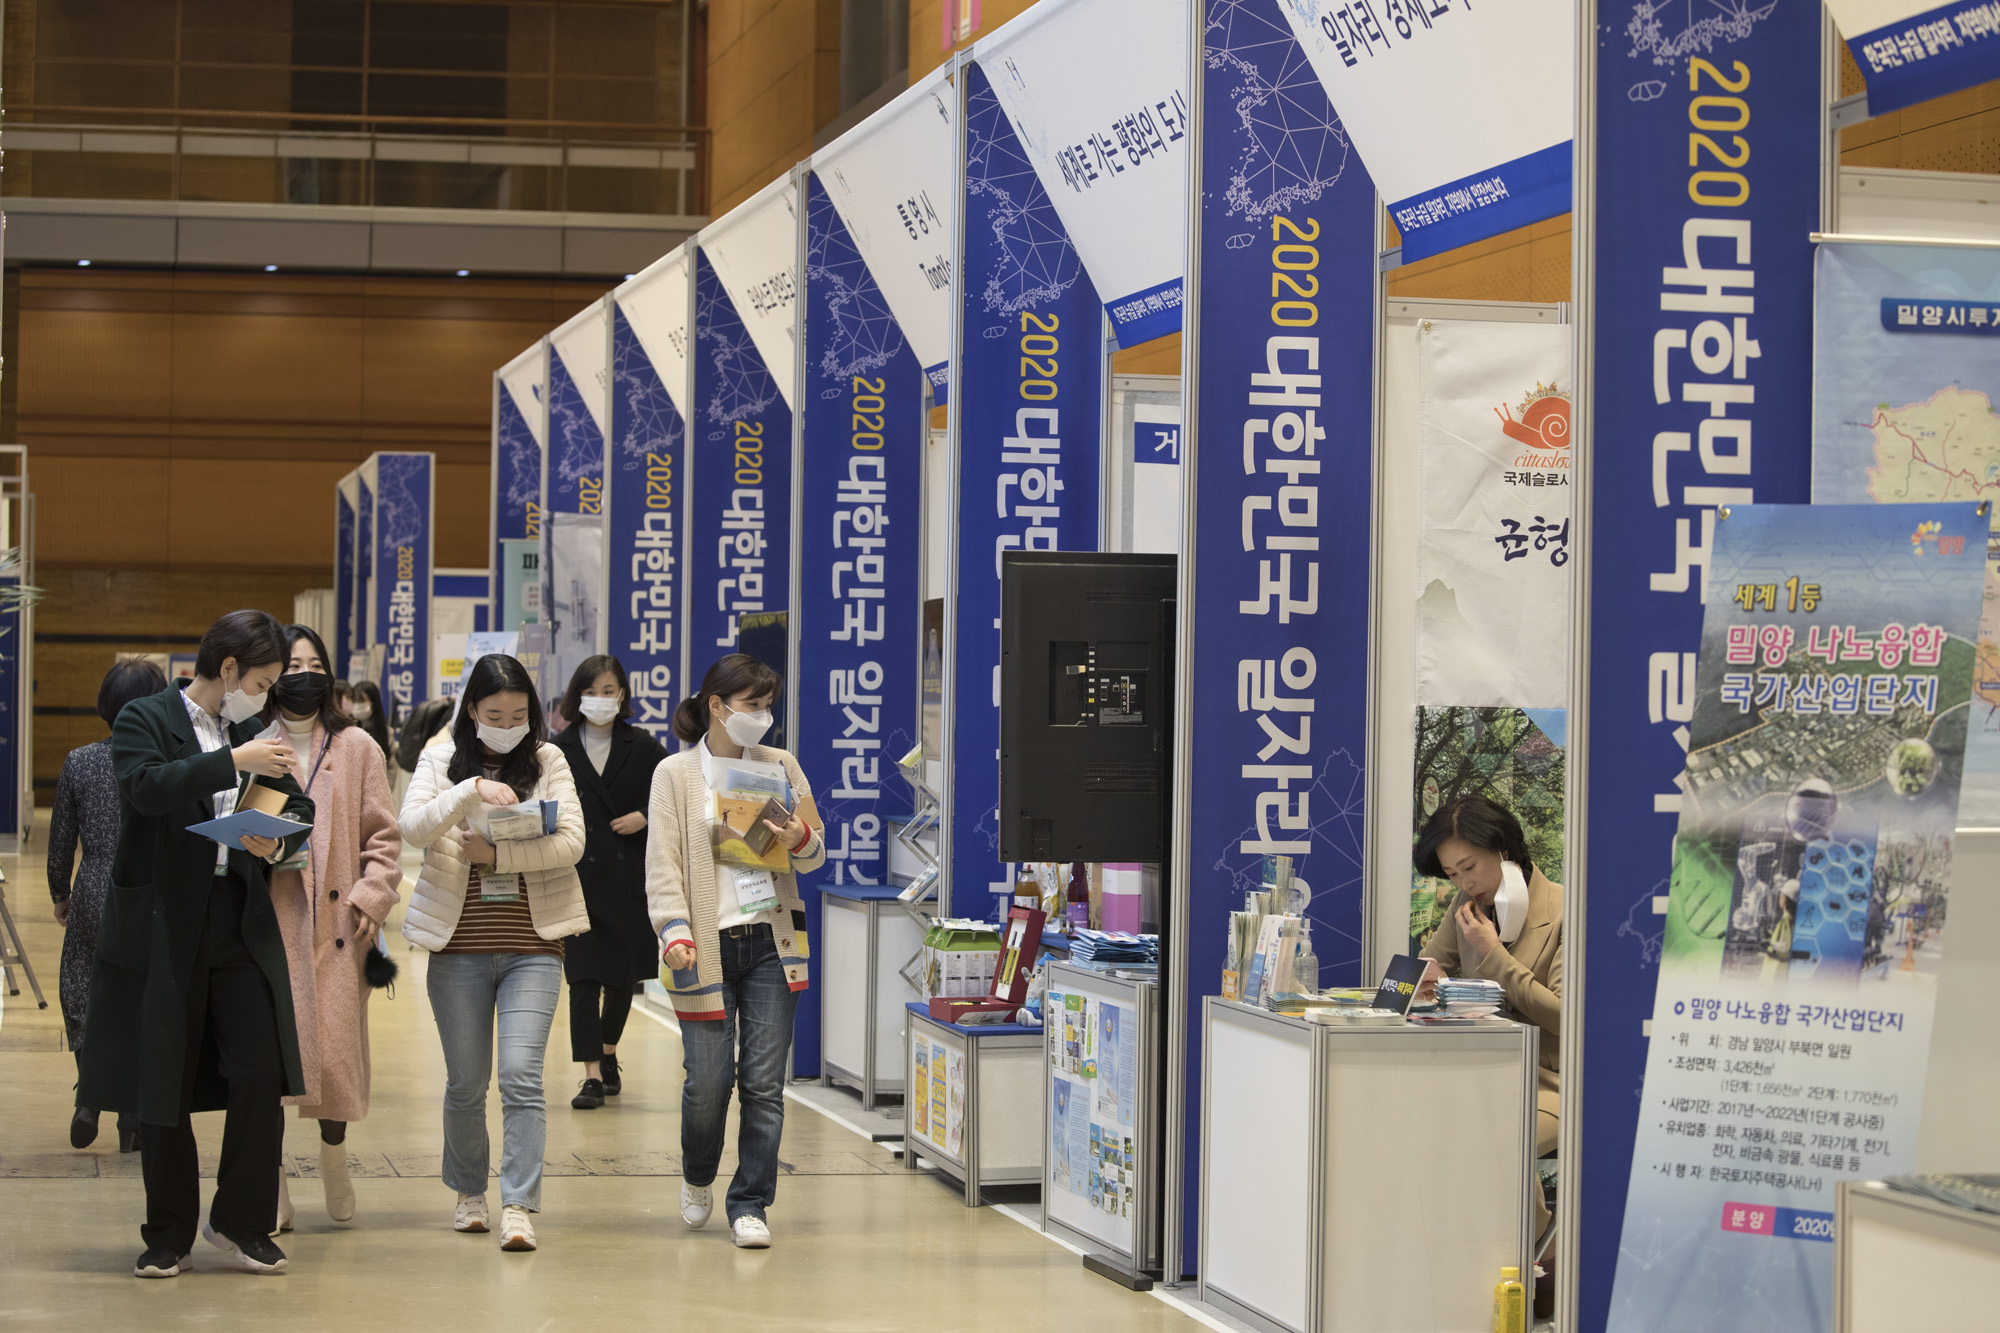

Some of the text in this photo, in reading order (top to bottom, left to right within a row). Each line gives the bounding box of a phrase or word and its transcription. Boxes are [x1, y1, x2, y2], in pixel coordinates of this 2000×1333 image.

[1321, 0, 1391, 68] 일자리
[1862, 36, 1904, 73] 한국판
[1894, 28, 1927, 63] 뉴딜
[1055, 145, 1099, 193] 세계로
[1087, 132, 1125, 178] 가는
[1112, 106, 1168, 167] 평화의
[896, 189, 942, 241] 통영시
[1395, 207, 1421, 232] 한국판
[1413, 203, 1433, 227] 뉴딜
[1444, 187, 1477, 215] 지역에서
[1469, 176, 1510, 207] 앞장섭니다
[918, 254, 951, 292] TongYe
[578, 476, 602, 514] 202
[1494, 515, 1569, 568] 균형
[1733, 576, 1822, 612] 세계 1등
[1726, 623, 1946, 668] 밀양 나노융합
[387, 671, 414, 724] 일자
[629, 664, 672, 746] 일자
[1720, 674, 1940, 715] 국가산업단지
[828, 660, 885, 799] 일자리
[1237, 646, 1317, 855] 일자리
[1691, 998, 1904, 1033] 밀양 나노융합 국가산업단지
[1728, 1036, 1749, 1051] 경남
[1753, 1037, 1786, 1054] 밀양시
[1789, 1040, 1824, 1057] 부북면
[1828, 1043, 1852, 1060] 일원
[1740, 1146, 1774, 1163] 비금속
[1808, 1153, 1844, 1170] 식료품
